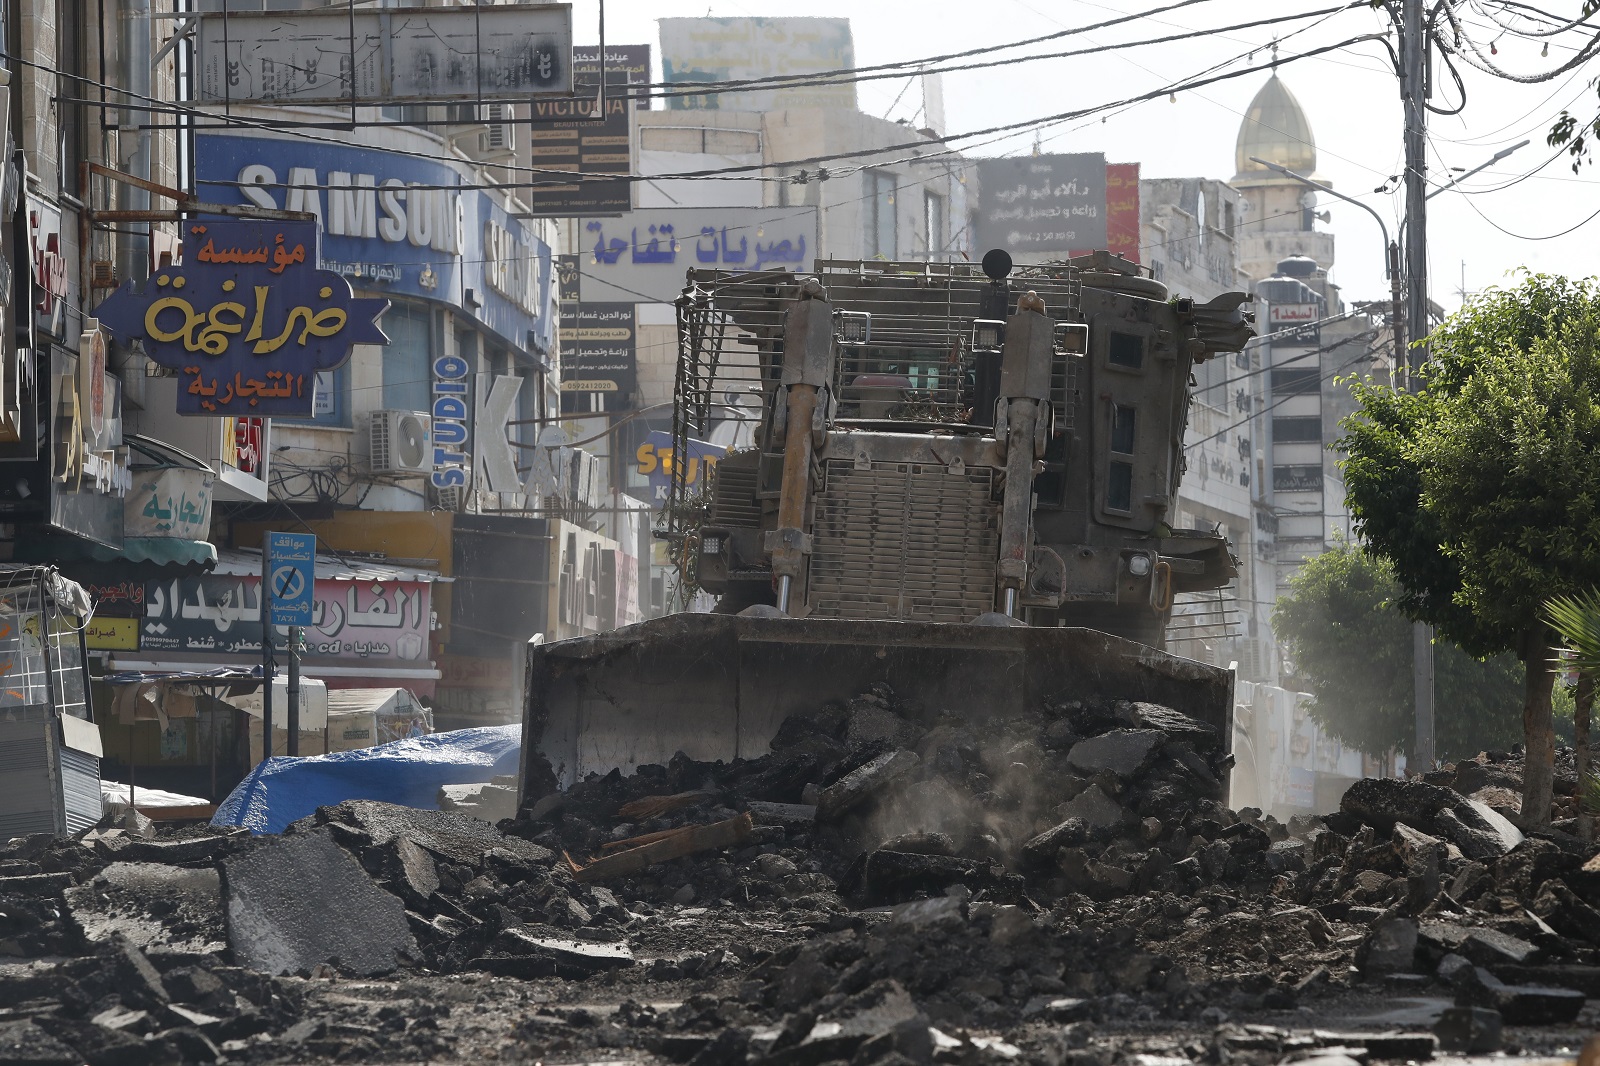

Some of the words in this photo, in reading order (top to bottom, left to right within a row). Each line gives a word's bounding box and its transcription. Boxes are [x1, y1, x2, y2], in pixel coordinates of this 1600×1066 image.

[303, 59, 317, 84] ctc
[537, 52, 552, 79] ctc
[227, 61, 239, 86] ctc
[237, 164, 464, 256] SAMSUNG
[191, 224, 306, 274] مؤسسة
[586, 221, 678, 264] تفاحة
[696, 225, 806, 275] بصريات
[145, 273, 348, 356] ضراغمة
[599, 311, 620, 321] الدين
[619, 311, 632, 320] نور
[577, 348, 609, 357] وتجميل
[609, 348, 628, 357] زراعة
[184, 366, 303, 412] التجارية
[567, 382, 612, 390] 0592412020
[430, 354, 469, 490] STUDIO
[274, 536, 305, 550] مواقف
[271, 602, 300, 613] تكسيا
[276, 614, 297, 623] TAXI
[186, 636, 216, 649] شنط
[225, 639, 263, 652] عطور
[318, 640, 342, 653] cd
[354, 639, 390, 655] هدايا
